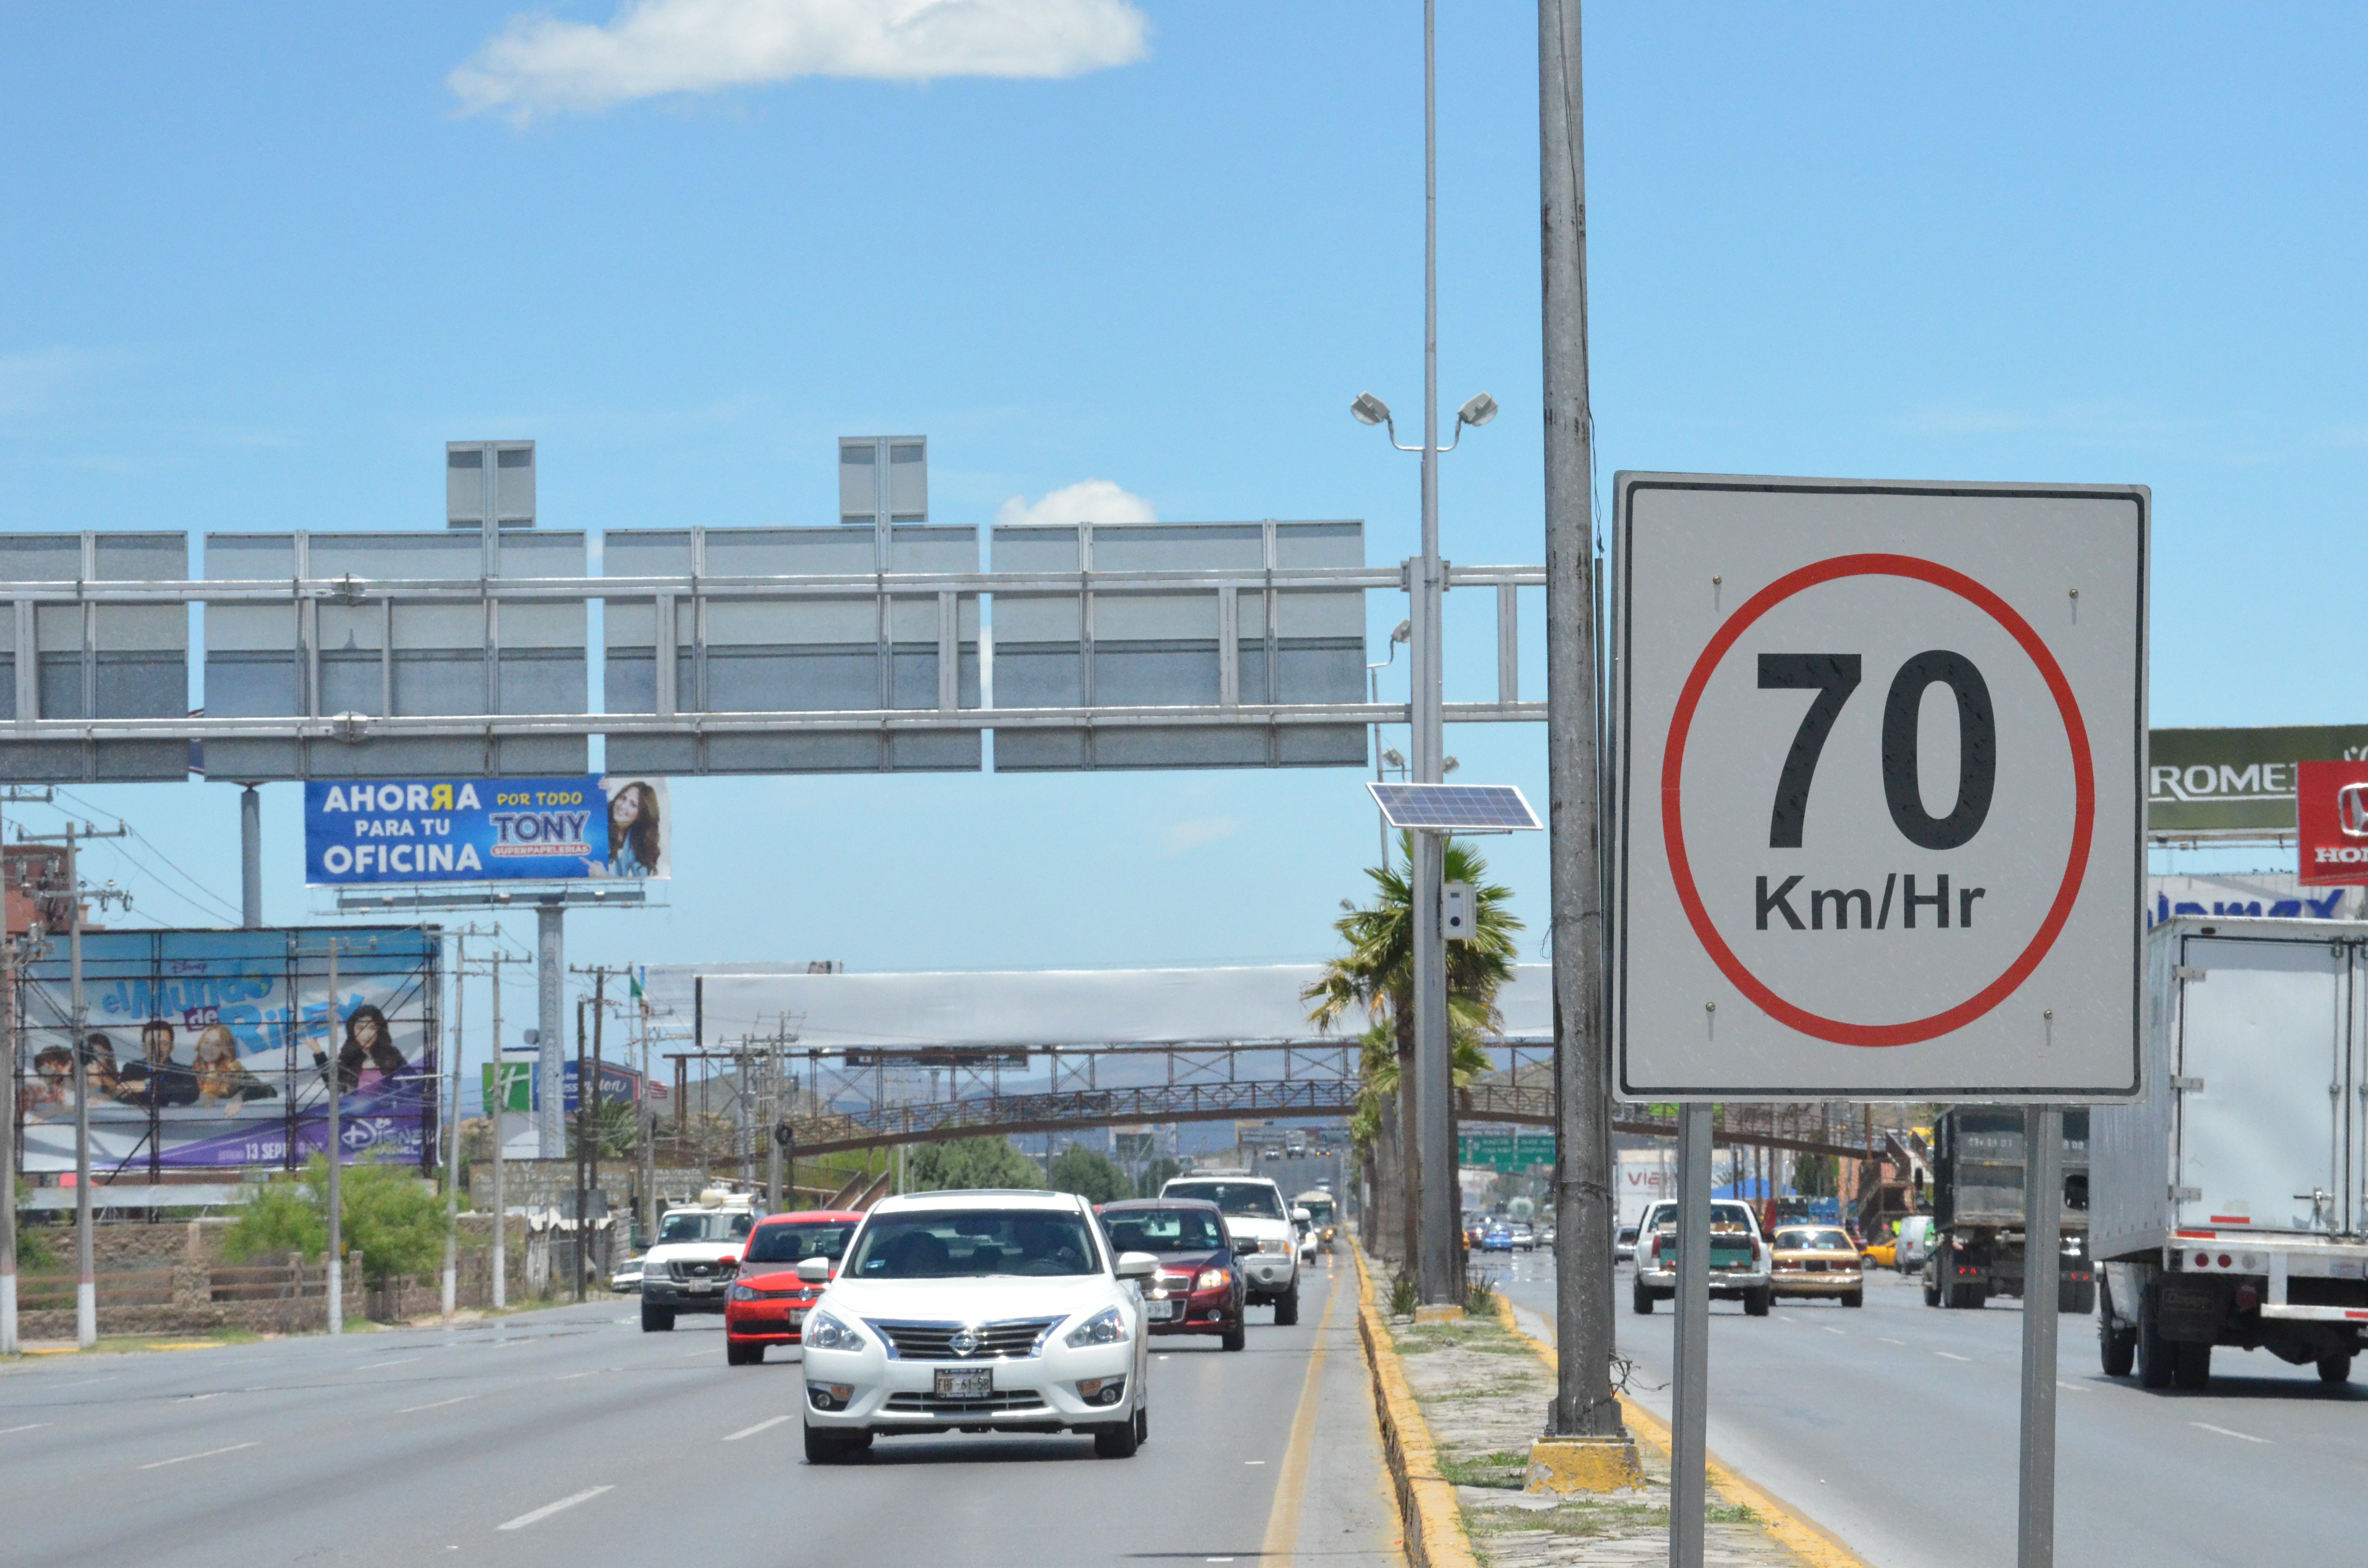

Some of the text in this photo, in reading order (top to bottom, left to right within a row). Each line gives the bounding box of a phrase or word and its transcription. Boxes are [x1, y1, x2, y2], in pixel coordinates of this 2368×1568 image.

[1758, 649, 1996, 850] 70
[497, 792, 582, 806] POR TODO
[355, 819, 450, 837] PARA TU
[491, 812, 589, 842] TONY
[323, 844, 482, 874] OFICINA
[1755, 873, 1986, 931] Km/Hr
[194, 1011, 219, 1026] de
[247, 1142, 258, 1160] 13
